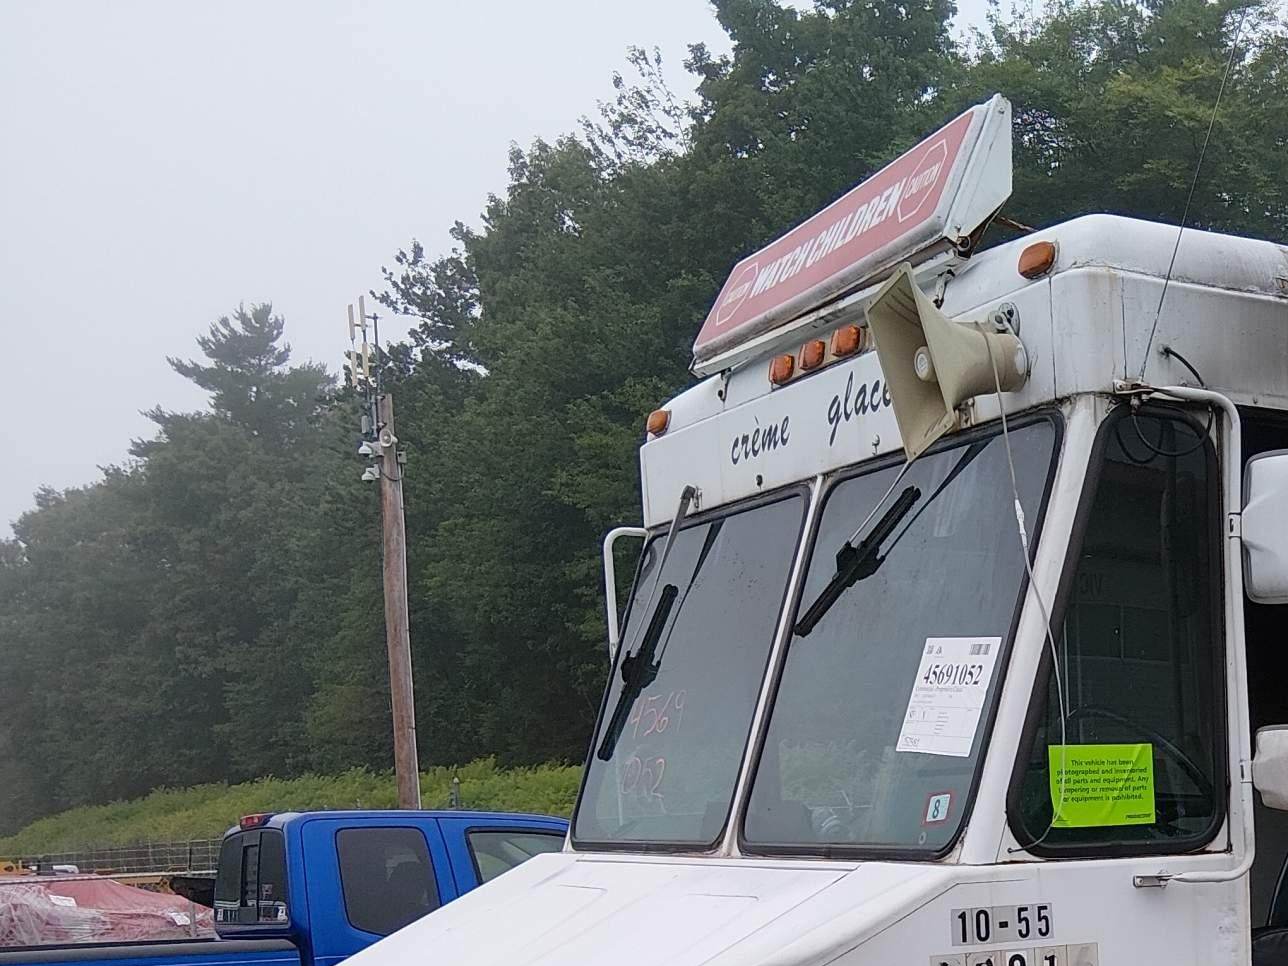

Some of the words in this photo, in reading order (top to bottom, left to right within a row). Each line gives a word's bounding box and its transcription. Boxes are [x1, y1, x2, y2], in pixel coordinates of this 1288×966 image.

[749, 245, 810, 299] WATCH
[805, 178, 907, 268] CHILDREN
[731, 416, 790, 465] crème
[923, 663, 983, 686] 45691052
[932, 797, 942, 820] 8
[957, 905, 1051, 943] 10-55
